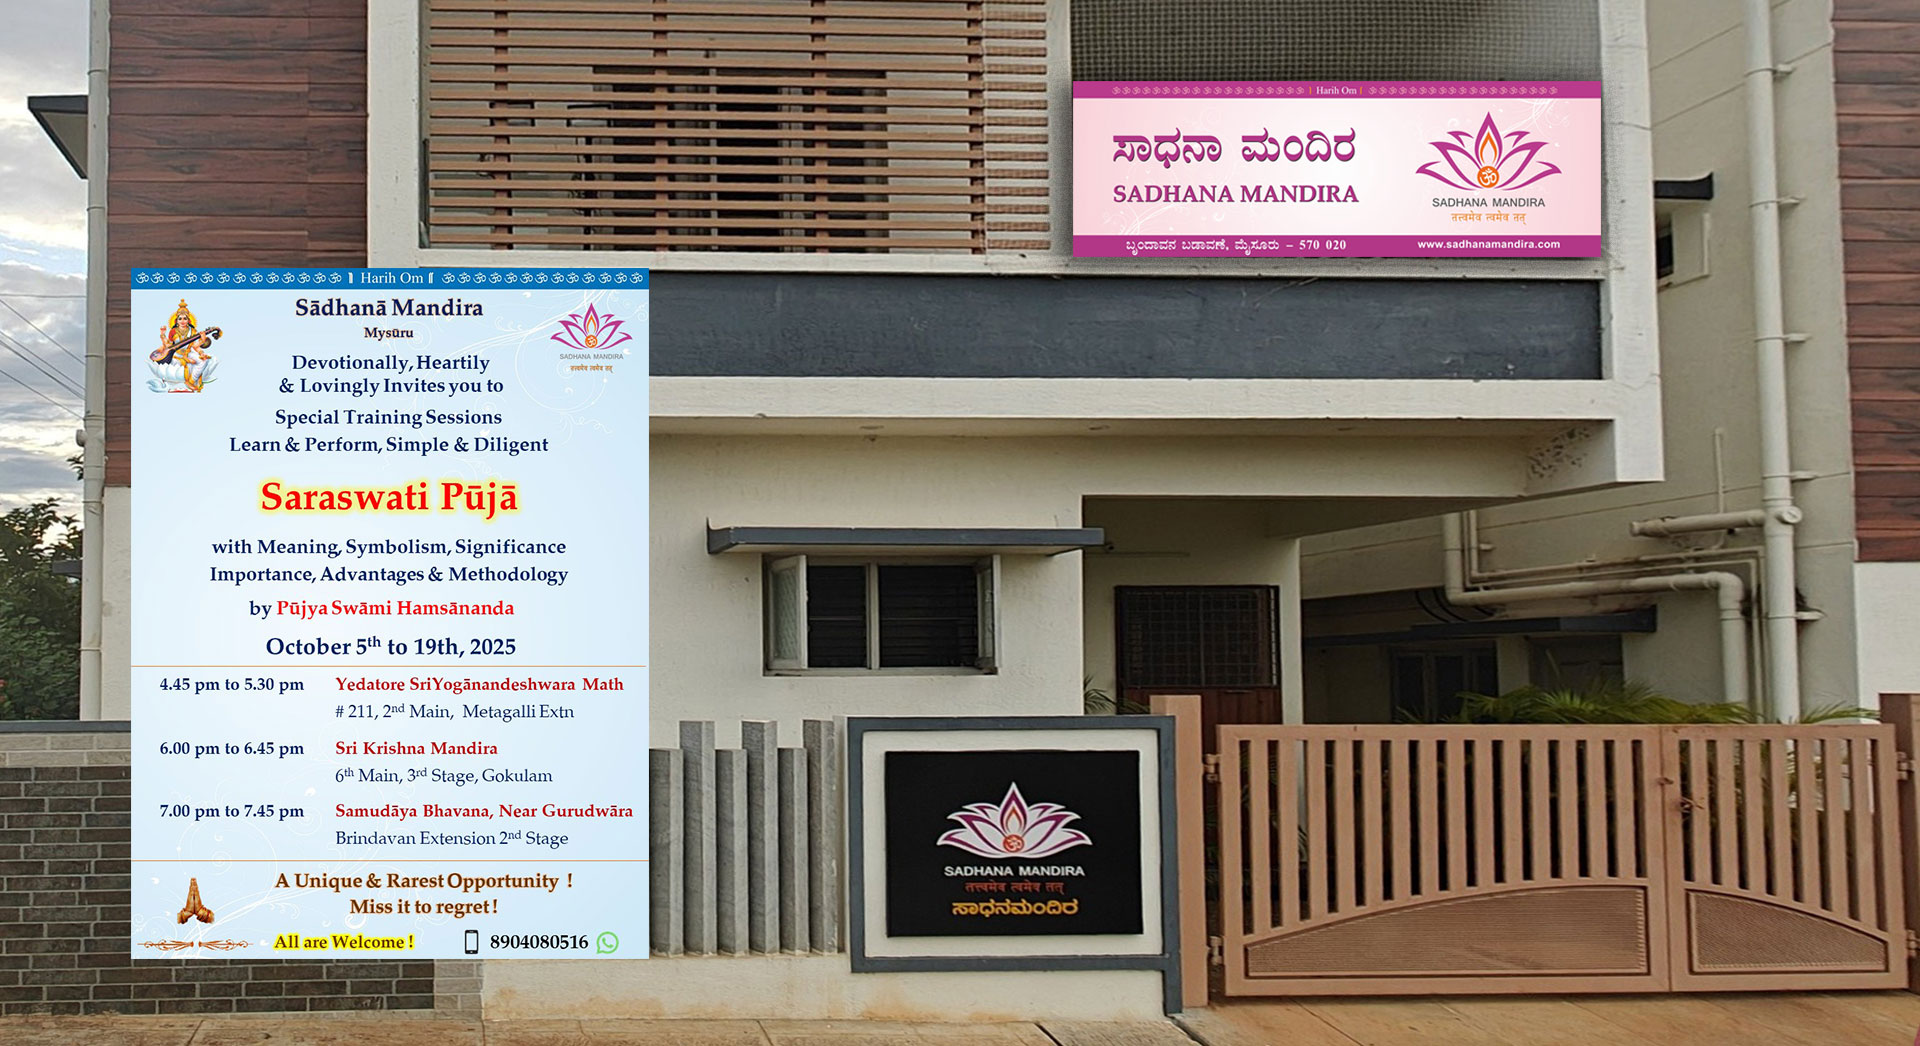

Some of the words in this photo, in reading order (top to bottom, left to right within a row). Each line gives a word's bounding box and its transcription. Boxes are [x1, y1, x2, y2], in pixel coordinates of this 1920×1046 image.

[945, 866, 1013, 876] SADHANA
[1019, 866, 1085, 876] MANDIRA
[951, 898, 1079, 918] ಸಾಧನಮಂದಿರ
